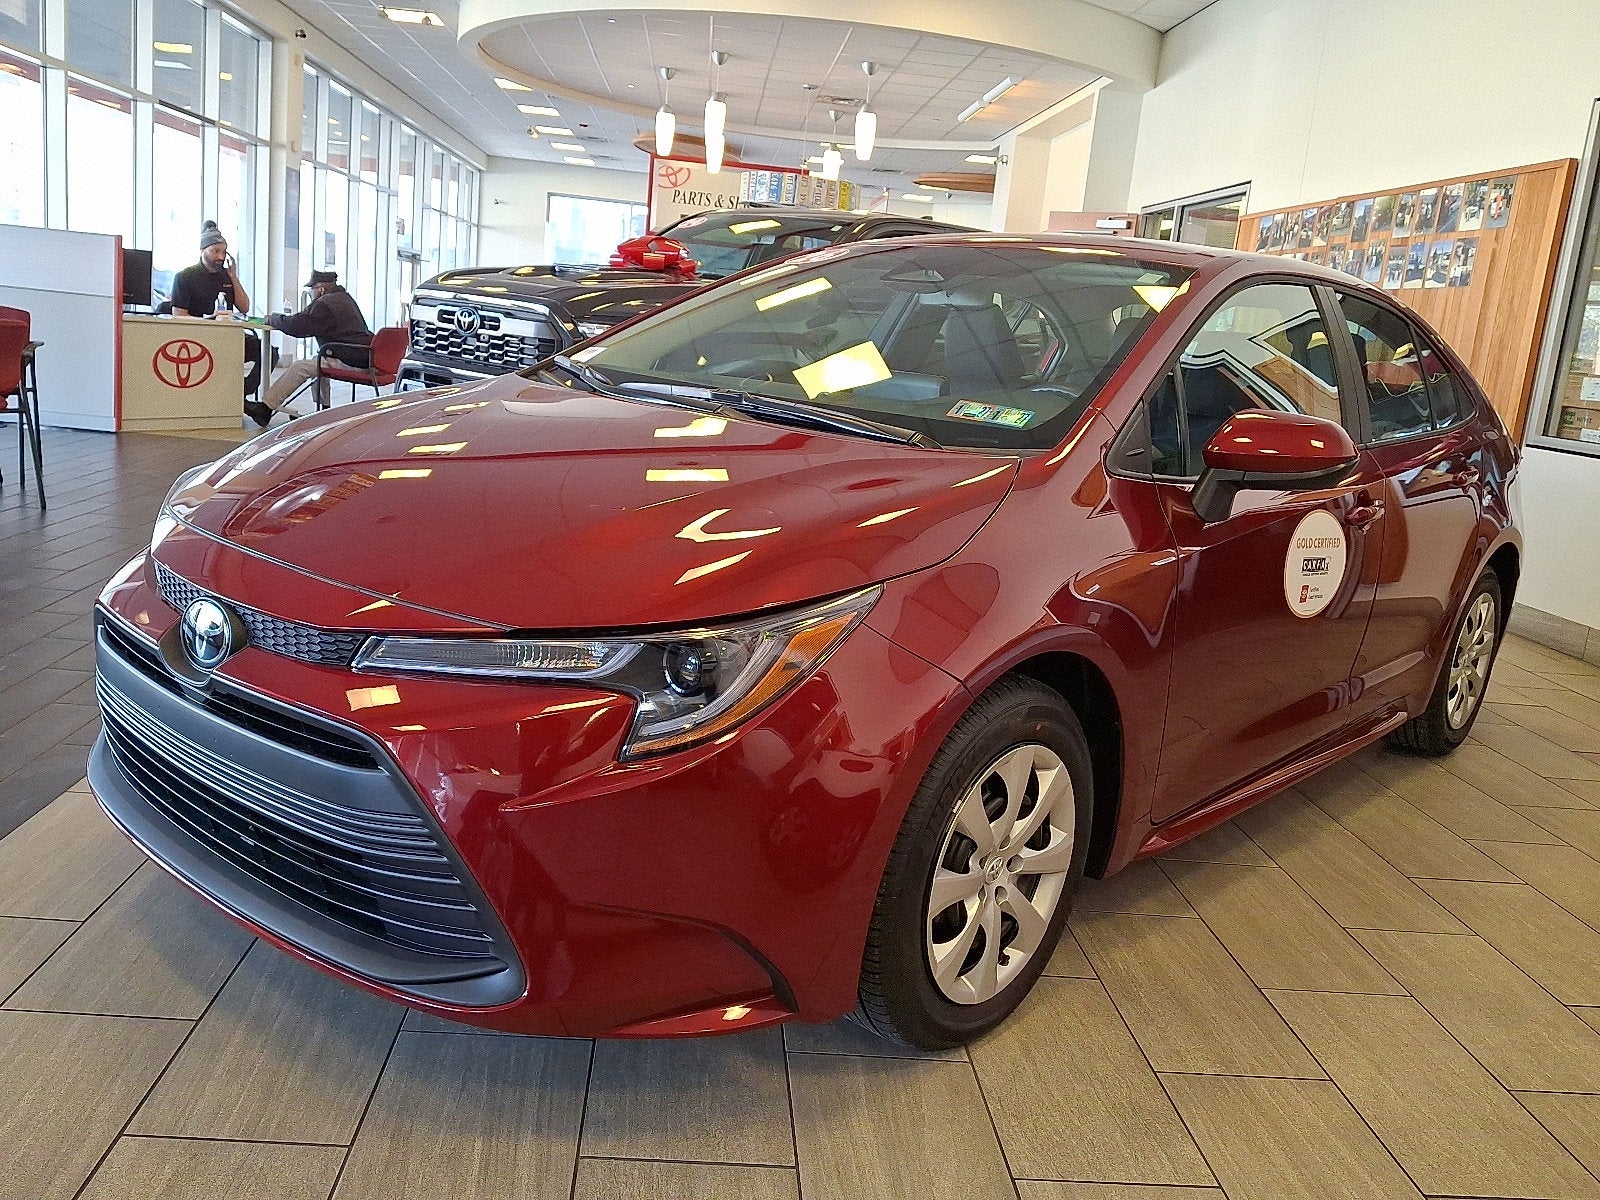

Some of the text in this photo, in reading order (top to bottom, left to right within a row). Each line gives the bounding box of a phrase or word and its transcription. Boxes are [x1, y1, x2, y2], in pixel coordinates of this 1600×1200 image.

[672, 189, 712, 207] PARTS
[714, 194, 724, 208] &
[1296, 537, 1341, 549] GOLD CERTIFIED
